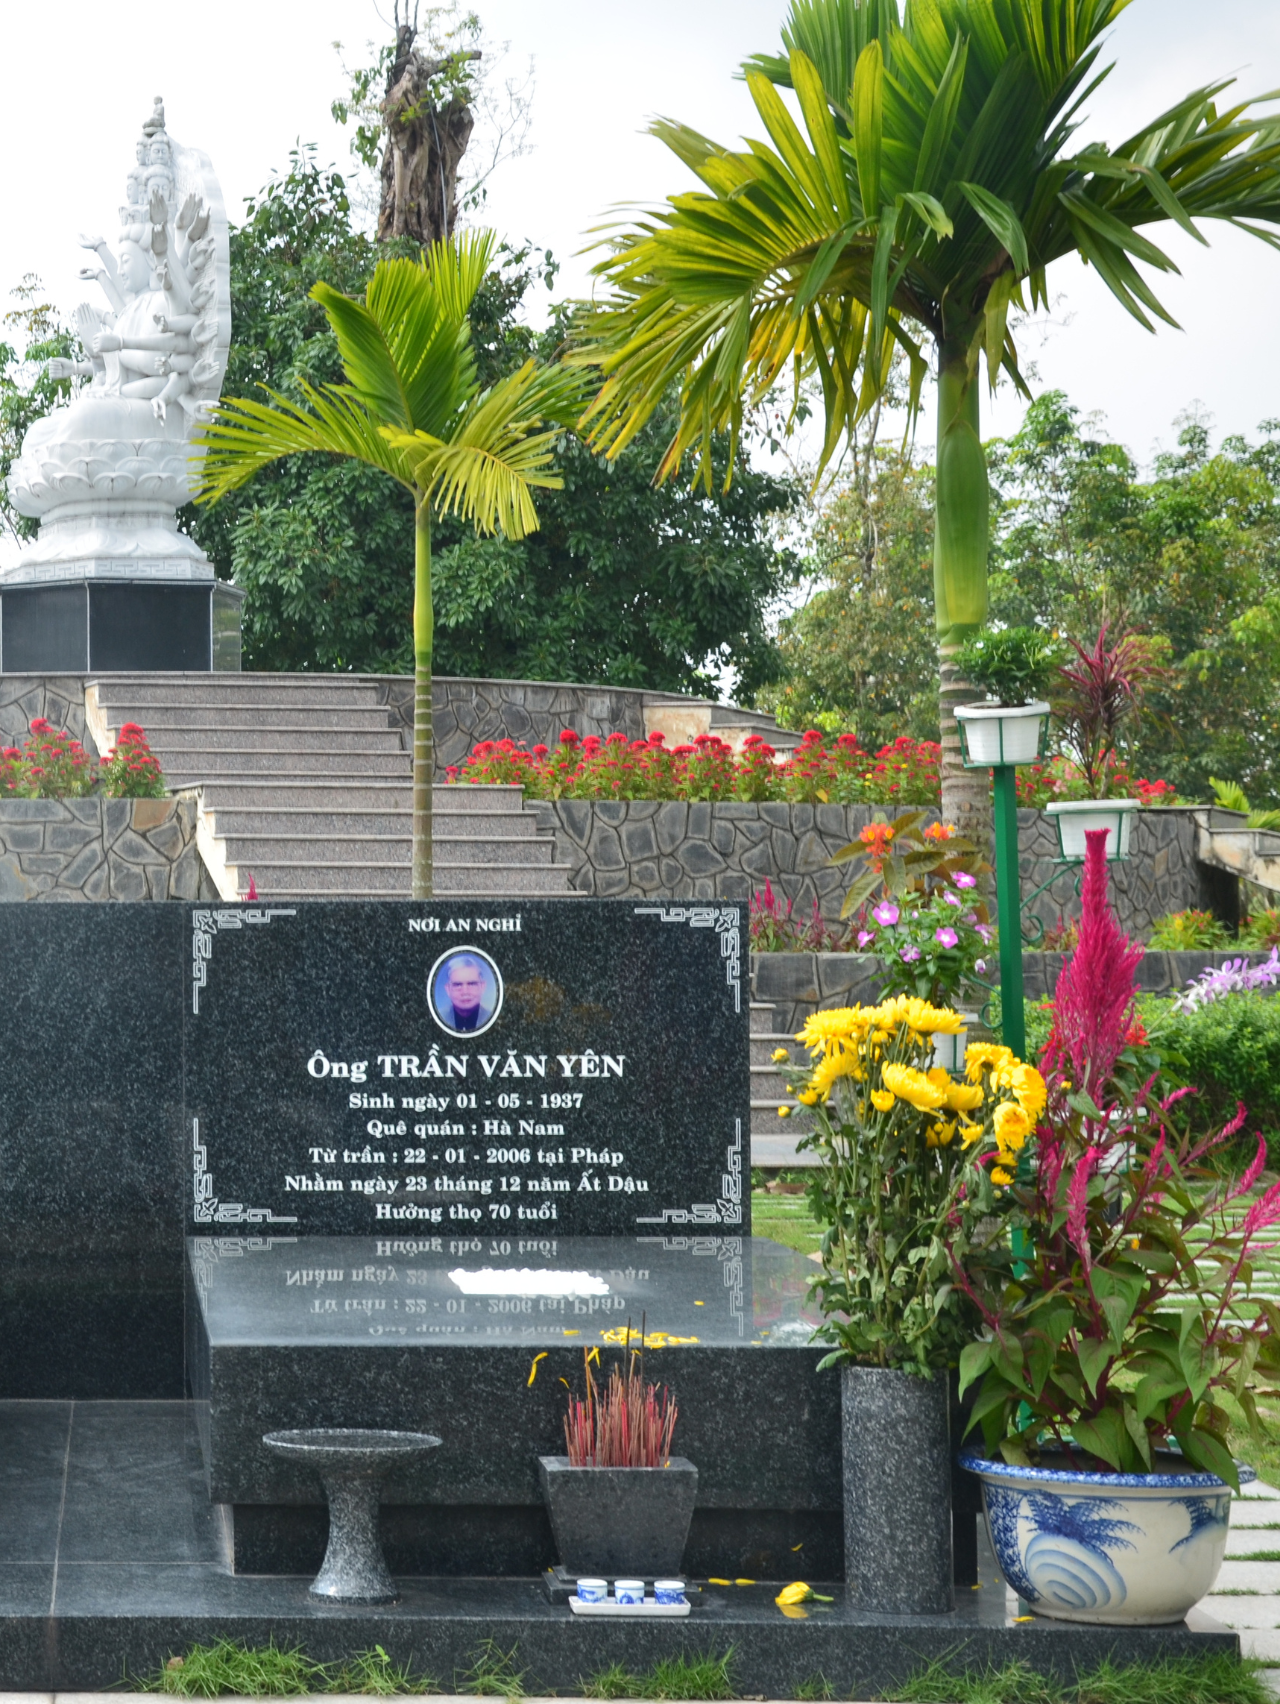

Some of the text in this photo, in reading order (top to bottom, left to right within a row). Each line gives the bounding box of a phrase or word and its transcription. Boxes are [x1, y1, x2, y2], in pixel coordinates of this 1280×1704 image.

[408, 913, 522, 933] NƠI AN NGHỈ
[306, 1042, 627, 1084] Ông TRẦN VĂN YÊN
[348, 1092, 396, 1109] Sinh
[401, 1092, 451, 1113] ngày
[456, 1092, 478, 1109] 01
[497, 1092, 521, 1109] 05
[540, 1092, 584, 1109] 1937
[366, 1119, 407, 1139] Quê
[413, 1119, 465, 1140] quán
[482, 1119, 512, 1136] Hà
[518, 1119, 565, 1136] Nam
[308, 1147, 338, 1164] Từ
[342, 1144, 386, 1164] trần
[403, 1147, 426, 1164] 22
[444, 1147, 466, 1164] 01
[486, 1147, 531, 1164] 2006
[536, 1147, 564, 1167] tại
[570, 1147, 624, 1168] Pháp
[284, 1168, 650, 1195] Nhằm ngày 23 tháng 12 năm Ất Dậu
[375, 1200, 558, 1223] Hưởng thọ 70 tuổi
